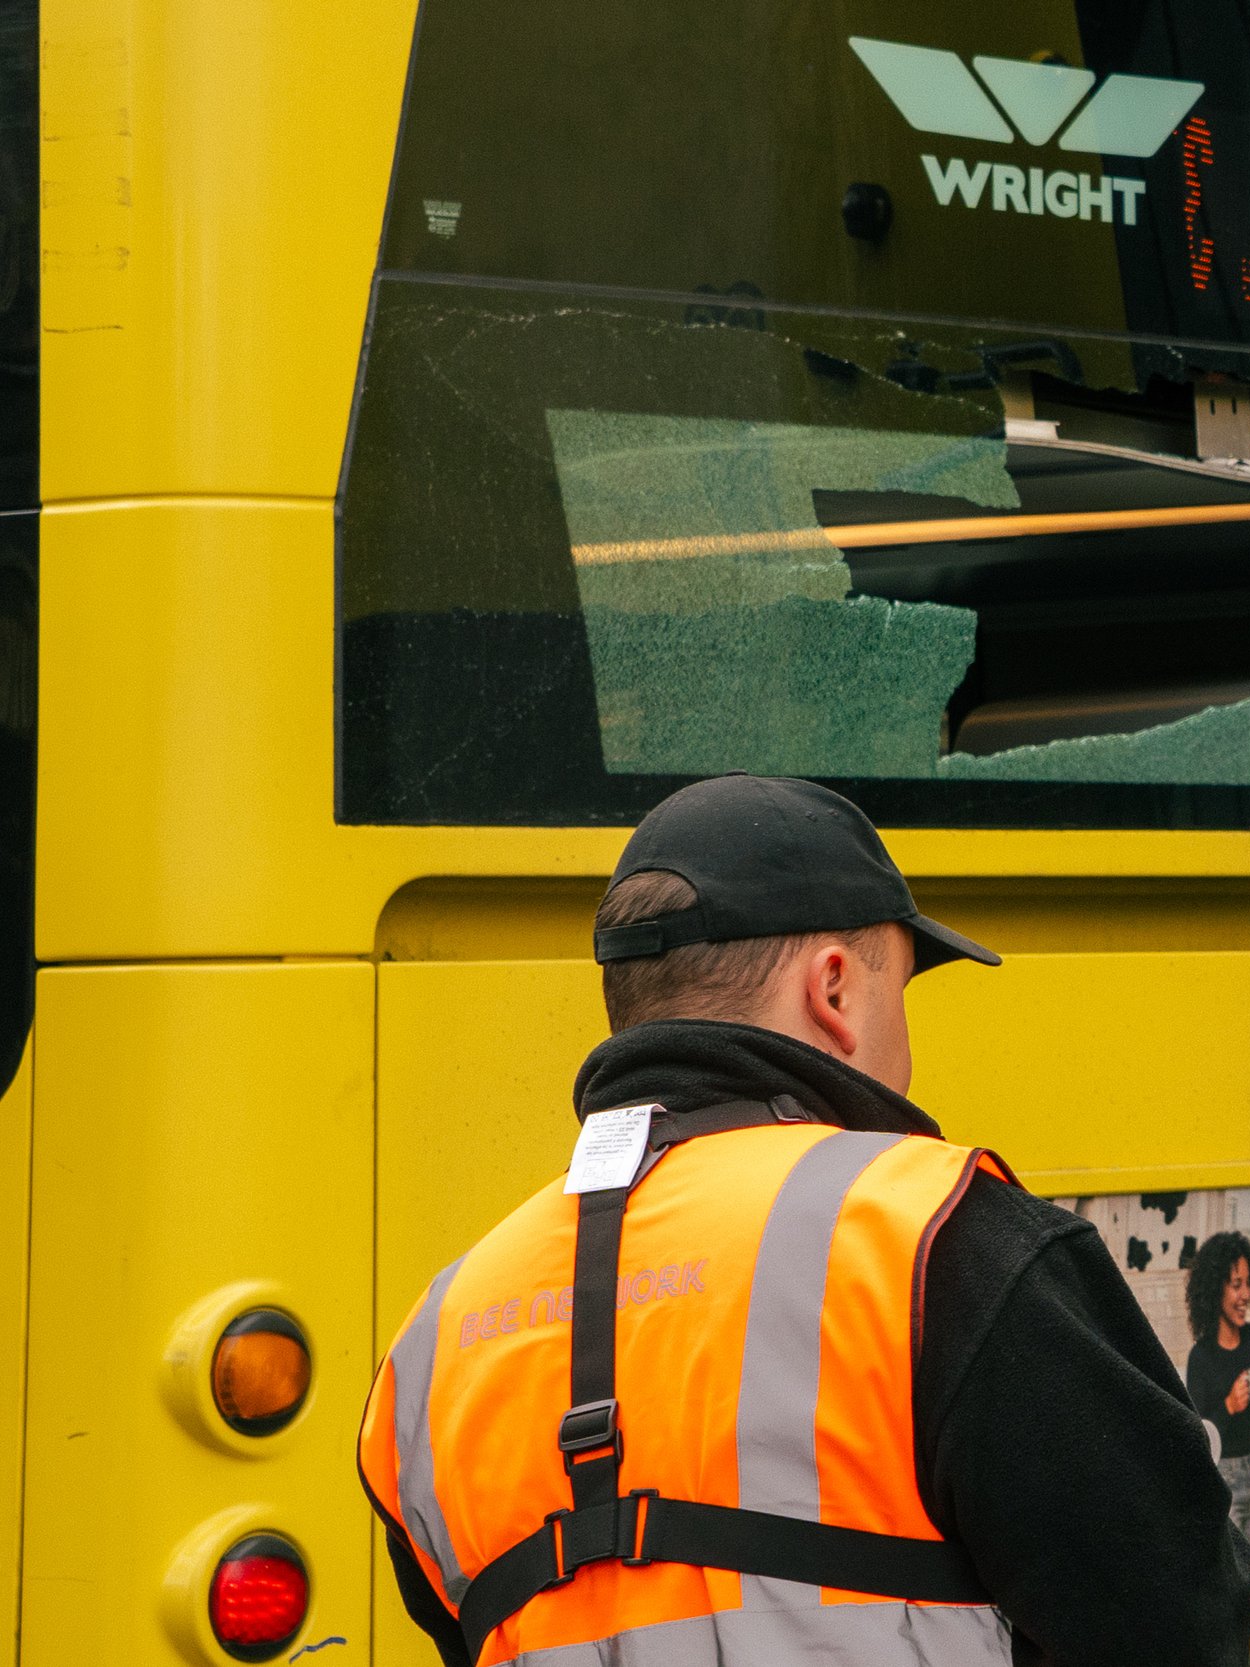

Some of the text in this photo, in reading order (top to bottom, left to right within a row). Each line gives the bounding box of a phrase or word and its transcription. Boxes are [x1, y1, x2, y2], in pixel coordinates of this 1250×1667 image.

[920, 154, 1147, 226] WRIGHT
[458, 1258, 709, 1349] BEE NEORK
